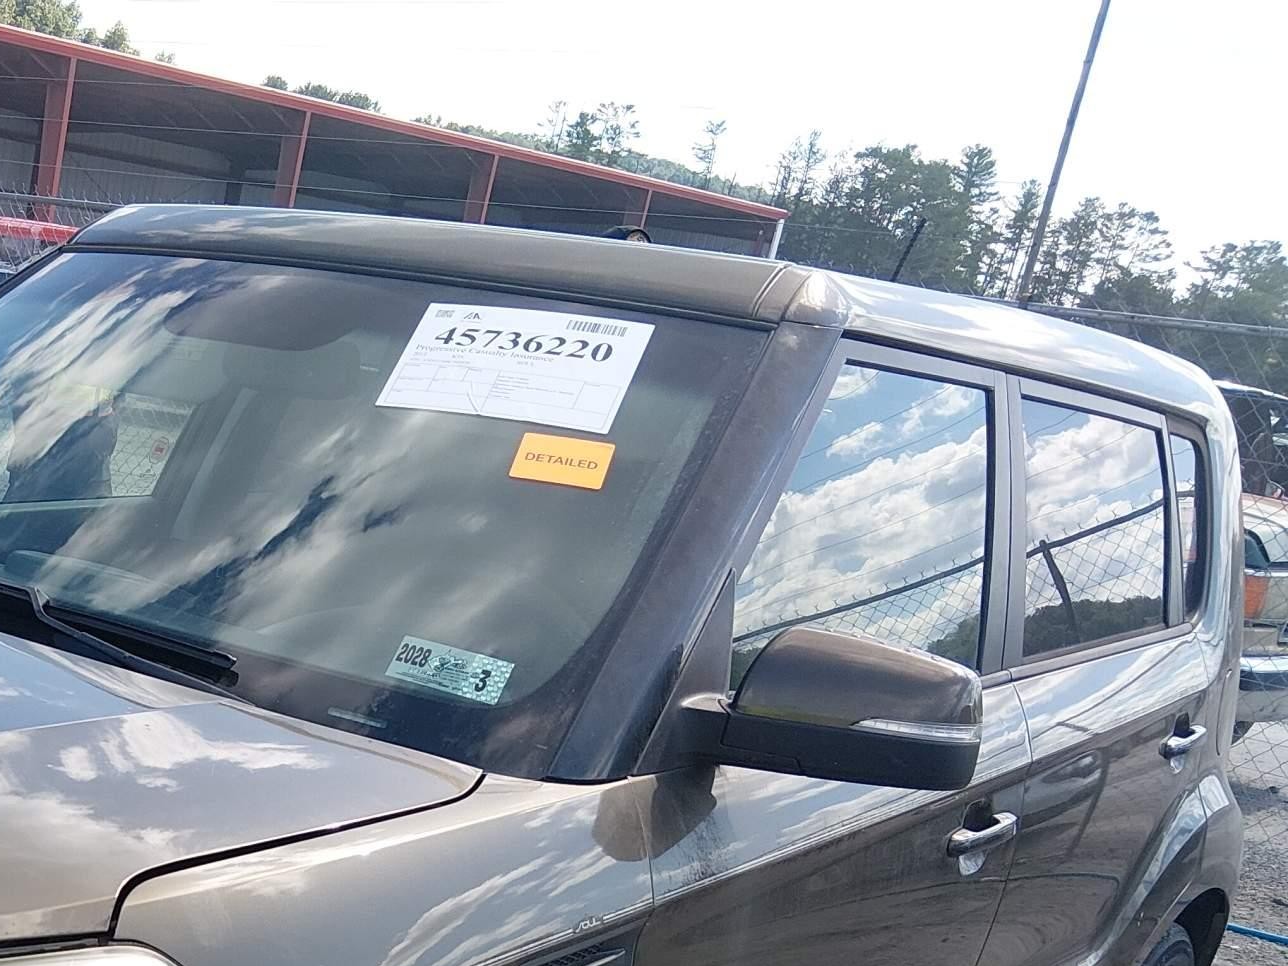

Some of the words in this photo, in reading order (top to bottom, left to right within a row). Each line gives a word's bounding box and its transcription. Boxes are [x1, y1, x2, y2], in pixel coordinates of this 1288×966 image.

[435, 327, 613, 362] 45736220
[524, 452, 599, 470] DETAILED
[395, 643, 432, 668] 2028
[474, 669, 492, 692] 3
